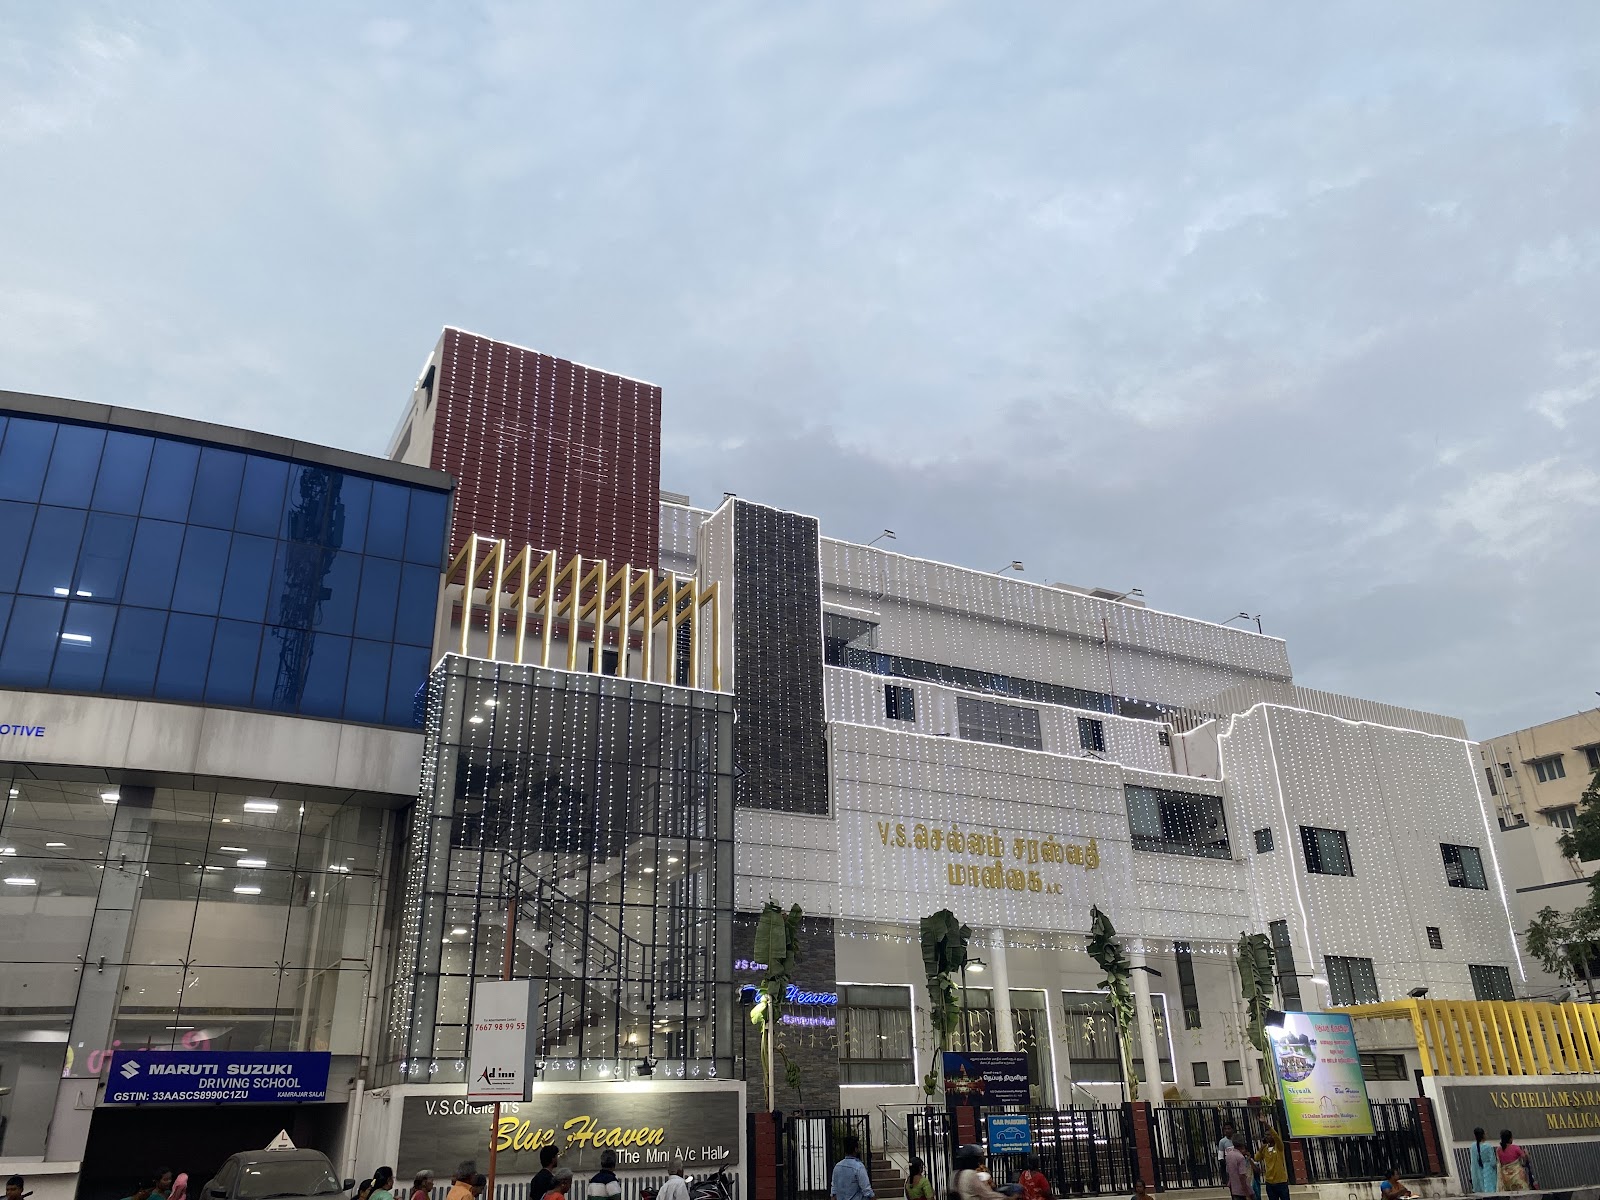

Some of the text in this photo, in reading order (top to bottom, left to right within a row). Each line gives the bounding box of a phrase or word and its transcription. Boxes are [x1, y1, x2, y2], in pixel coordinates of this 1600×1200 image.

[1012, 834, 1100, 872] சரஸ்வதி
[785, 984, 838, 1004] Heaven
[475, 1022, 526, 1031] 7667 98 99 55
[149, 1064, 293, 1075] MARUTI SUZUKI
[199, 1078, 301, 1089] DRIVING SCHOOL
[113, 1092, 150, 1101] GSTIN:
[281, 1131, 288, 1141] L
[489, 1115, 665, 1152] Blue Heaven
[615, 1145, 723, 1164] The Mini A/c Hall
